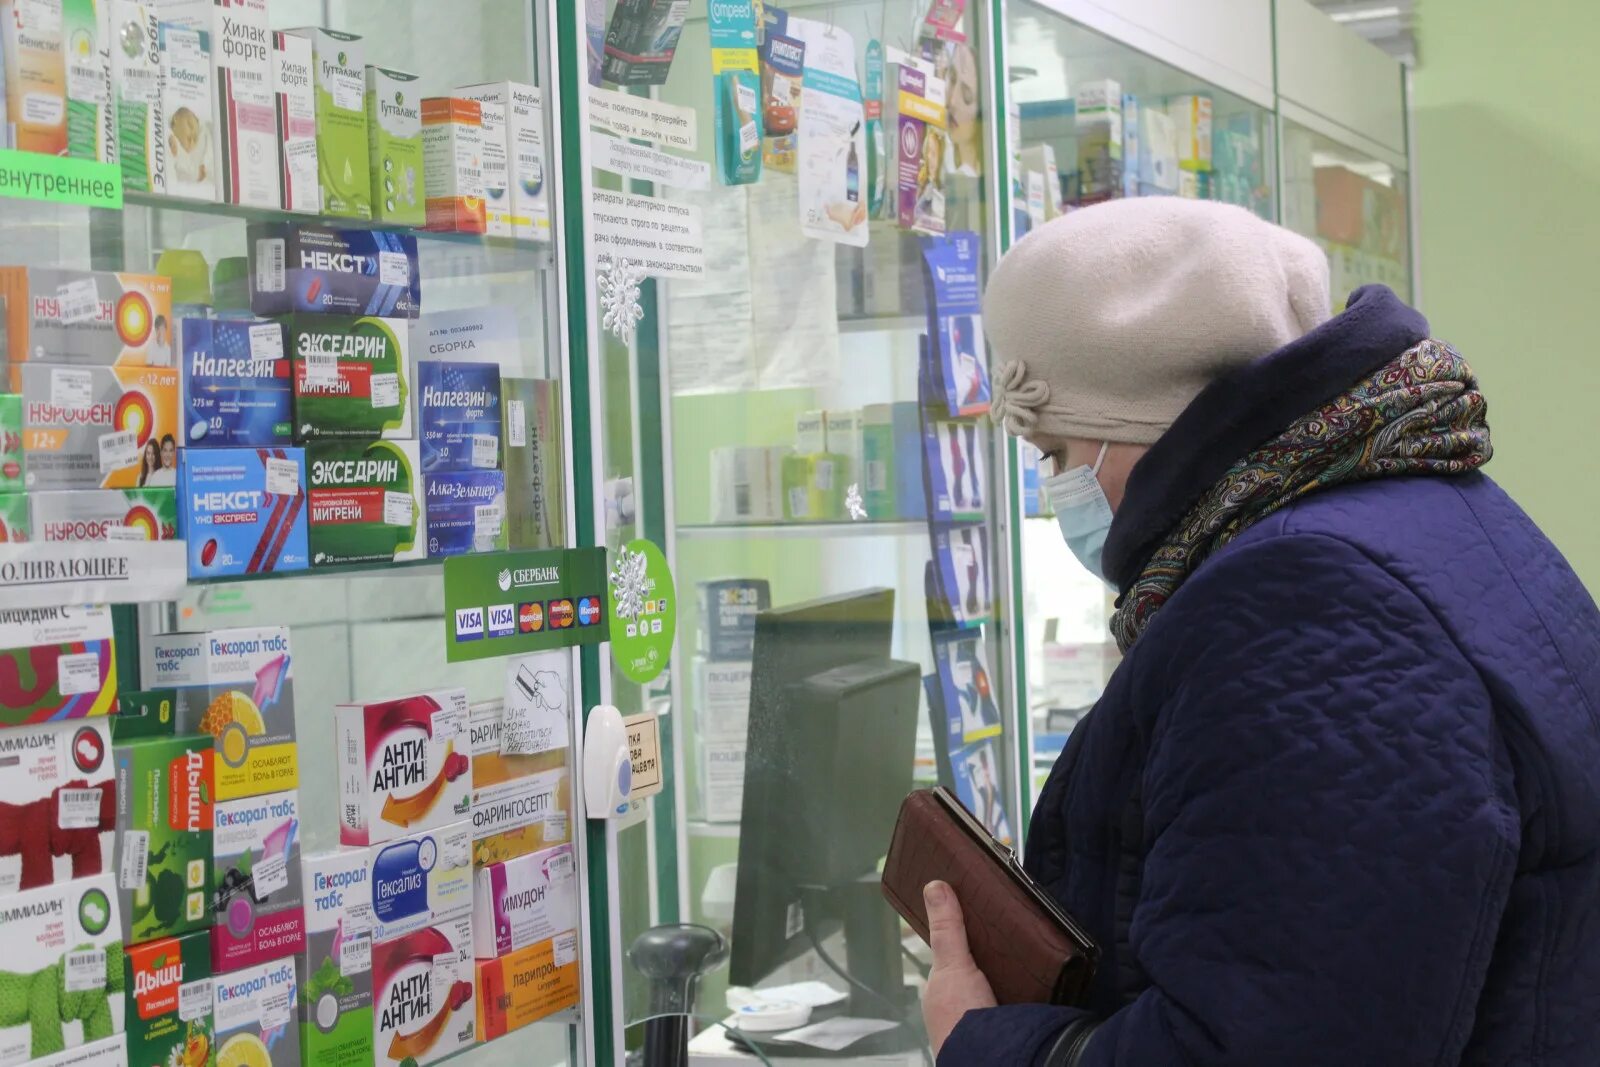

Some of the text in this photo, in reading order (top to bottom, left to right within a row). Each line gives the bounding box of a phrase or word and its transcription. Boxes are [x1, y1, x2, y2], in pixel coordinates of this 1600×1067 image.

[222, 16, 266, 43] Хилак
[222, 39, 267, 61] форте
[170, 67, 205, 83] Боботик
[281, 60, 307, 74] Хилак
[322, 60, 363, 80] Гутталакс
[281, 72, 308, 87] форте
[512, 91, 540, 104] Афлубин
[381, 100, 418, 119] Гутталакс
[0, 168, 115, 199] внутреннее
[626, 197, 666, 213] рецептурного
[668, 204, 690, 217] отпуска
[630, 218, 651, 229] строго
[610, 232, 657, 249] оформленным
[665, 242, 703, 255] соответствии
[300, 250, 366, 274] НЕКСТ
[646, 258, 703, 273] законодательством
[322, 294, 333, 305] 20
[298, 333, 386, 358] ЭКСЕДРИН
[429, 339, 476, 354] СБОРКА
[192, 351, 274, 379] Налгезин
[160, 375, 177, 386] лет
[423, 385, 485, 407] Налгезин
[209, 416, 223, 429] 10
[465, 407, 484, 420] форте
[31, 432, 57, 446] 12+
[440, 447, 449, 457] 10
[312, 459, 398, 485] ЭКСЕДРИН
[428, 480, 496, 500] Алка-Зельтцер
[193, 490, 262, 511] НЕКСТ
[195, 513, 257, 525] УНО ЭКСПРЕСС
[313, 505, 362, 521] МИГРЕНИ
[222, 553, 233, 566] 20
[513, 566, 560, 584] СБЕРБАНК
[459, 611, 483, 629] VISA
[490, 608, 513, 625] VISA
[155, 647, 200, 659] Гексорал
[210, 635, 288, 658] Гексорал табс
[156, 660, 180, 672] табс
[252, 755, 291, 768] ОСЛАБЛЯЮТ
[382, 738, 424, 768] АНТИ
[253, 772, 270, 782] БОЛЬ
[270, 769, 276, 779] В
[276, 767, 294, 778] ГОРЛЕ
[373, 761, 426, 792] АНГИН
[186, 748, 203, 833] Дыши
[215, 799, 295, 827] Гексорал табс
[472, 791, 550, 827] ФАРИНГОСЕПТ
[314, 867, 367, 891] Гексорал
[377, 873, 422, 900] Гексализ
[314, 889, 343, 911] табс
[501, 885, 545, 913] ИМУДОН
[258, 919, 299, 938] ОСЛАБЛЯЮТ
[373, 924, 385, 940] 30
[259, 931, 302, 951] БОЛЬ В ГОРЛЕ
[459, 949, 467, 962] 24
[133, 963, 183, 999] Дыши
[217, 964, 293, 1003] Гексорал табс
[512, 962, 562, 988] Ларипрон
[390, 971, 430, 1006] АНТИ
[380, 993, 431, 1032] АНГИН
